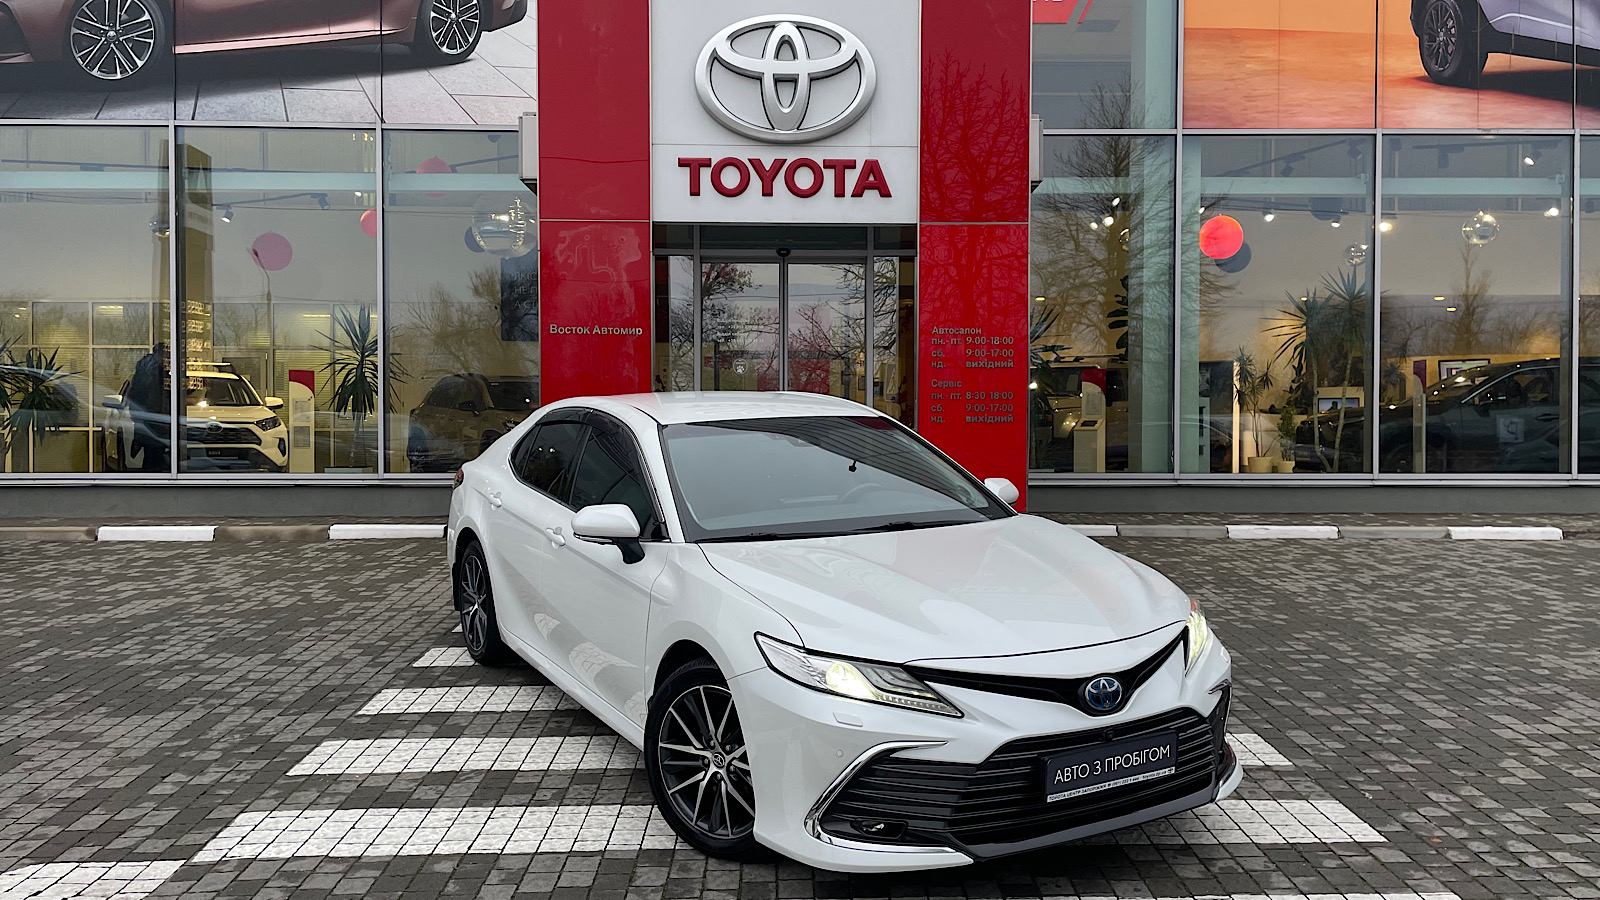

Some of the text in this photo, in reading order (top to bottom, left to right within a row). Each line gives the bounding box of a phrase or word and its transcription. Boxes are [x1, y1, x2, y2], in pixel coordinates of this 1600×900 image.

[678, 157, 892, 198] TOYOTA
[550, 324, 643, 336] Восток Автомир
[932, 326, 982, 334] Автосалон
[931, 348, 1014, 358] сб. 9:00-17:00
[931, 359, 1014, 369] нд. вихідний
[931, 379, 962, 389] Сервіс
[931, 403, 1014, 412] сб. 9:00-17:00
[965, 414, 1014, 423] вихідний
[1054, 763, 1090, 784] АВТО
[1105, 744, 1170, 773] ПРОБІГОМ
